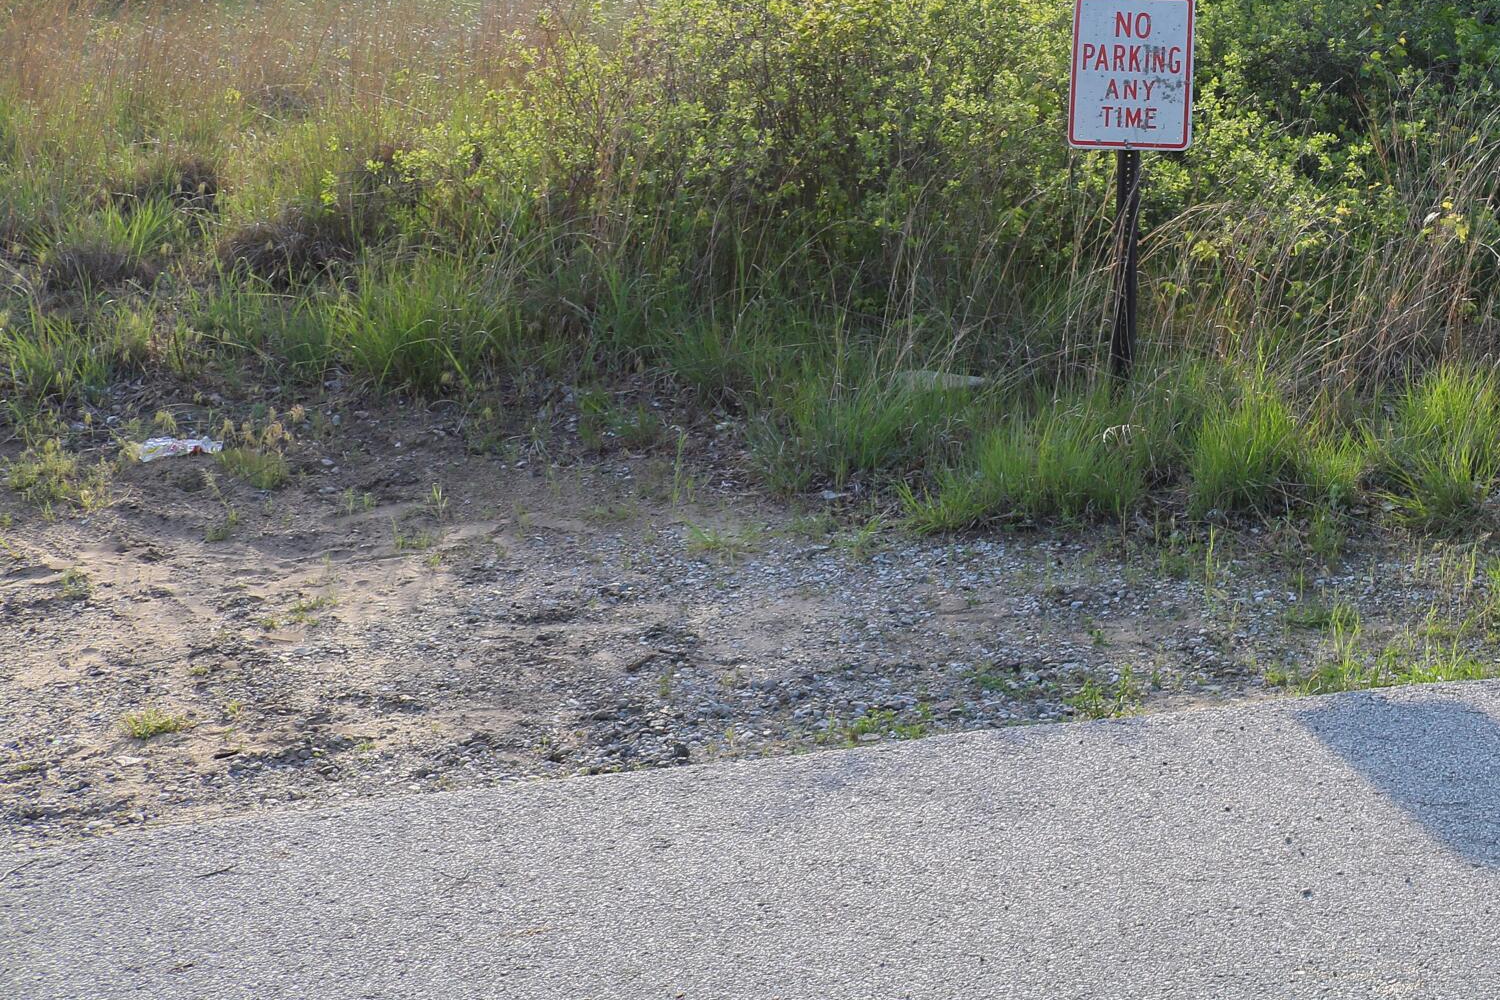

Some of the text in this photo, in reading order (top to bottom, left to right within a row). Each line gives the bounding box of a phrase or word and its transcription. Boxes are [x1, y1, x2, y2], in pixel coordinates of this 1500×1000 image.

[1115, 11, 1151, 39] NO
[1082, 43, 1181, 74] PARKING
[1104, 78, 1156, 101] ANY
[1101, 106, 1157, 129] TIME
